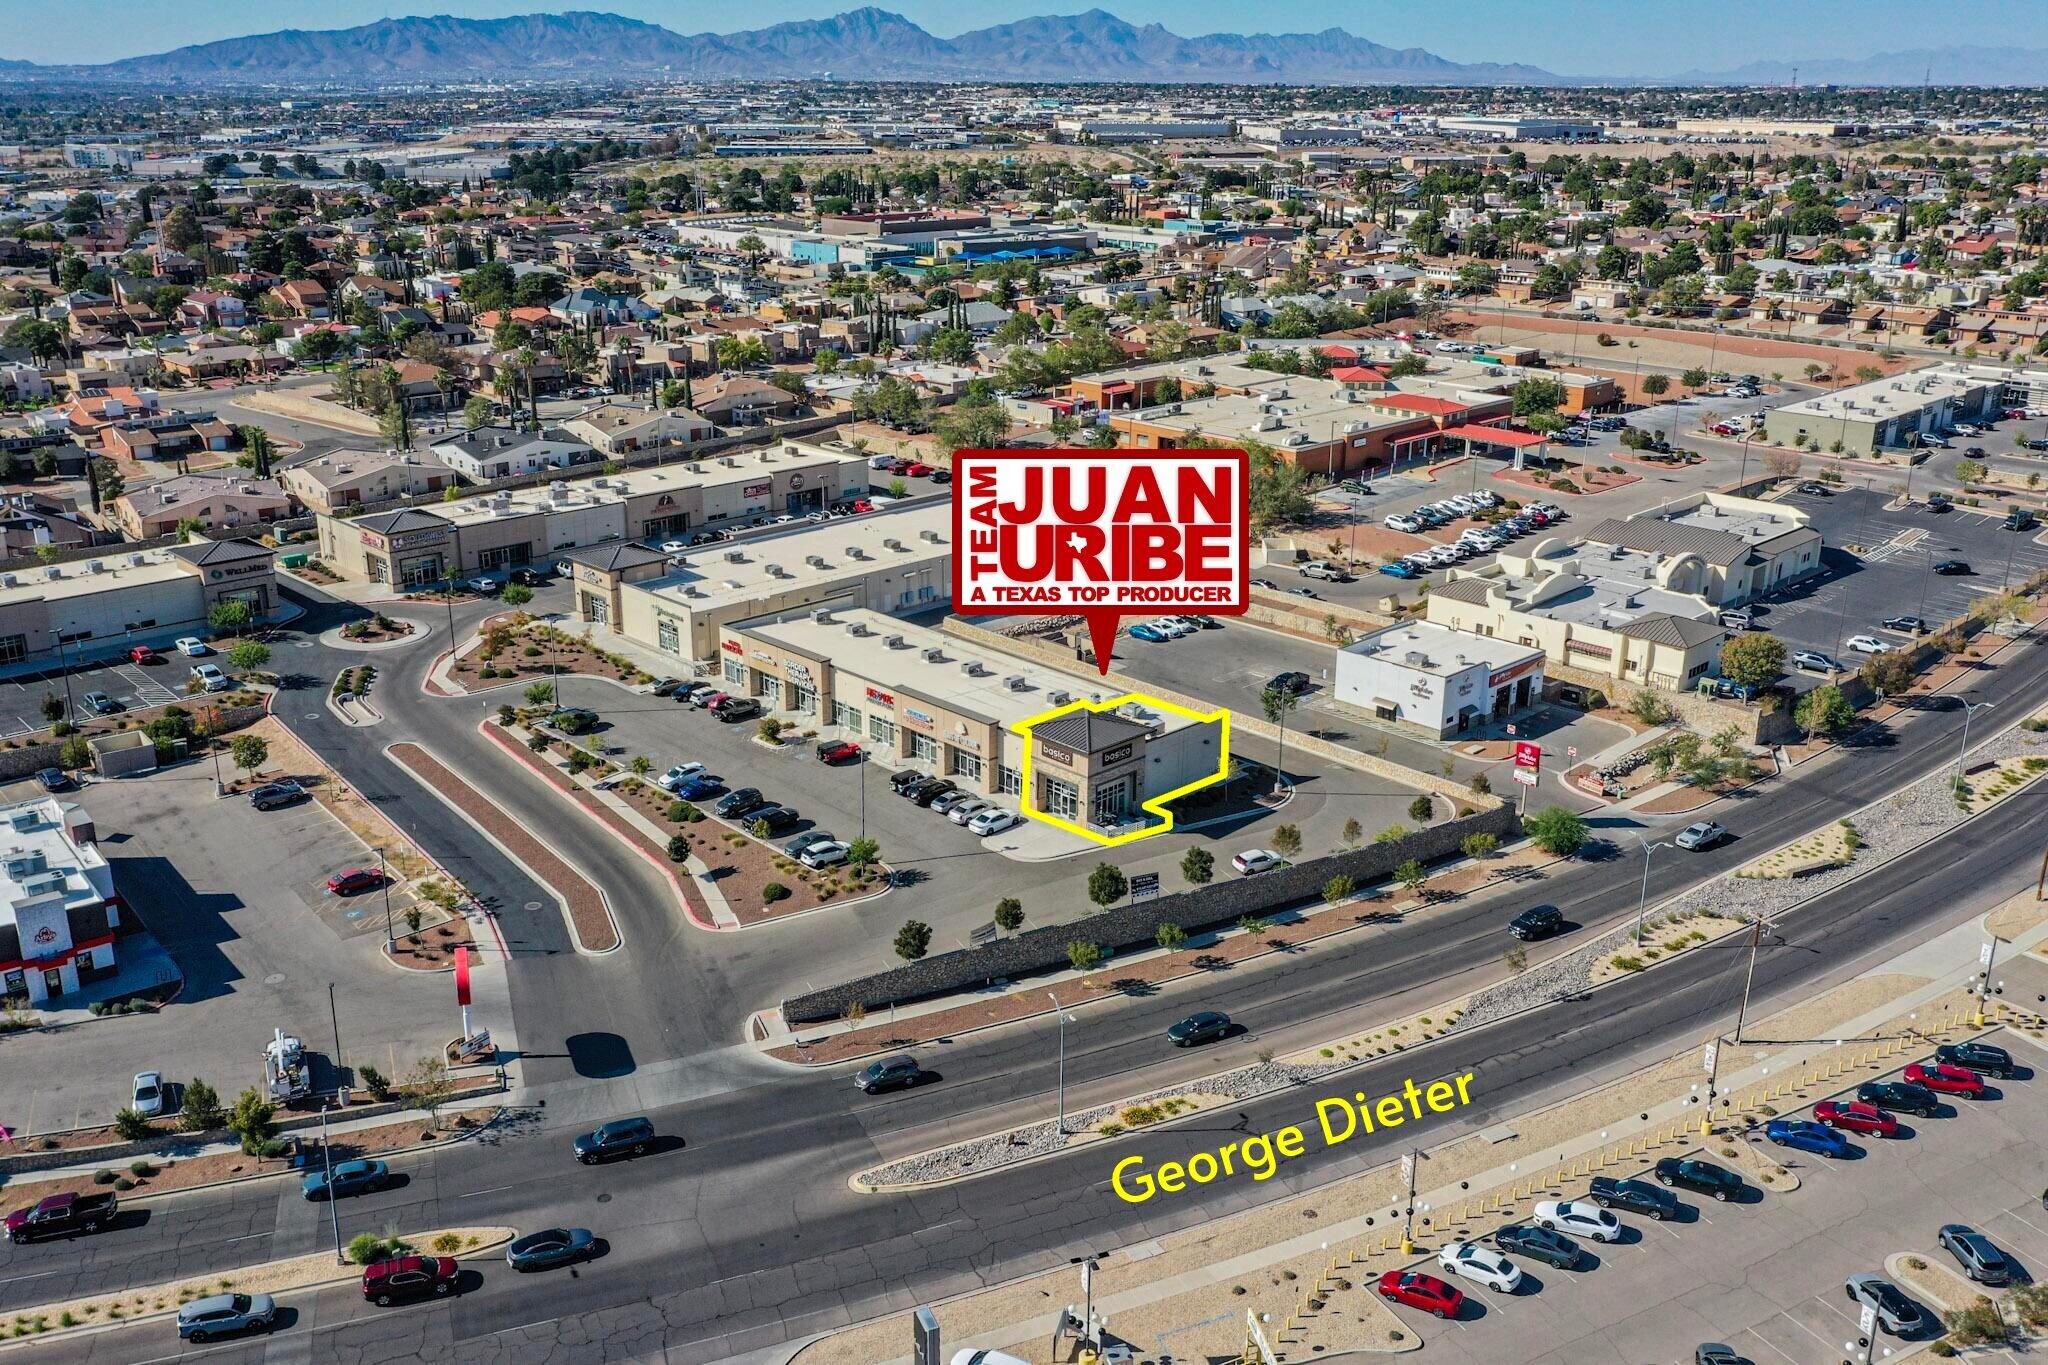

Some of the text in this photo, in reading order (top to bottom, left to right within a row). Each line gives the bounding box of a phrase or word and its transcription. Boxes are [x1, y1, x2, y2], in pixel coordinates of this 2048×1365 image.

[784, 659, 807, 673] BORDER
[786, 667, 811, 681] THERAPY
[1043, 745, 1071, 761] basico
[1104, 747, 1131, 762] basico
